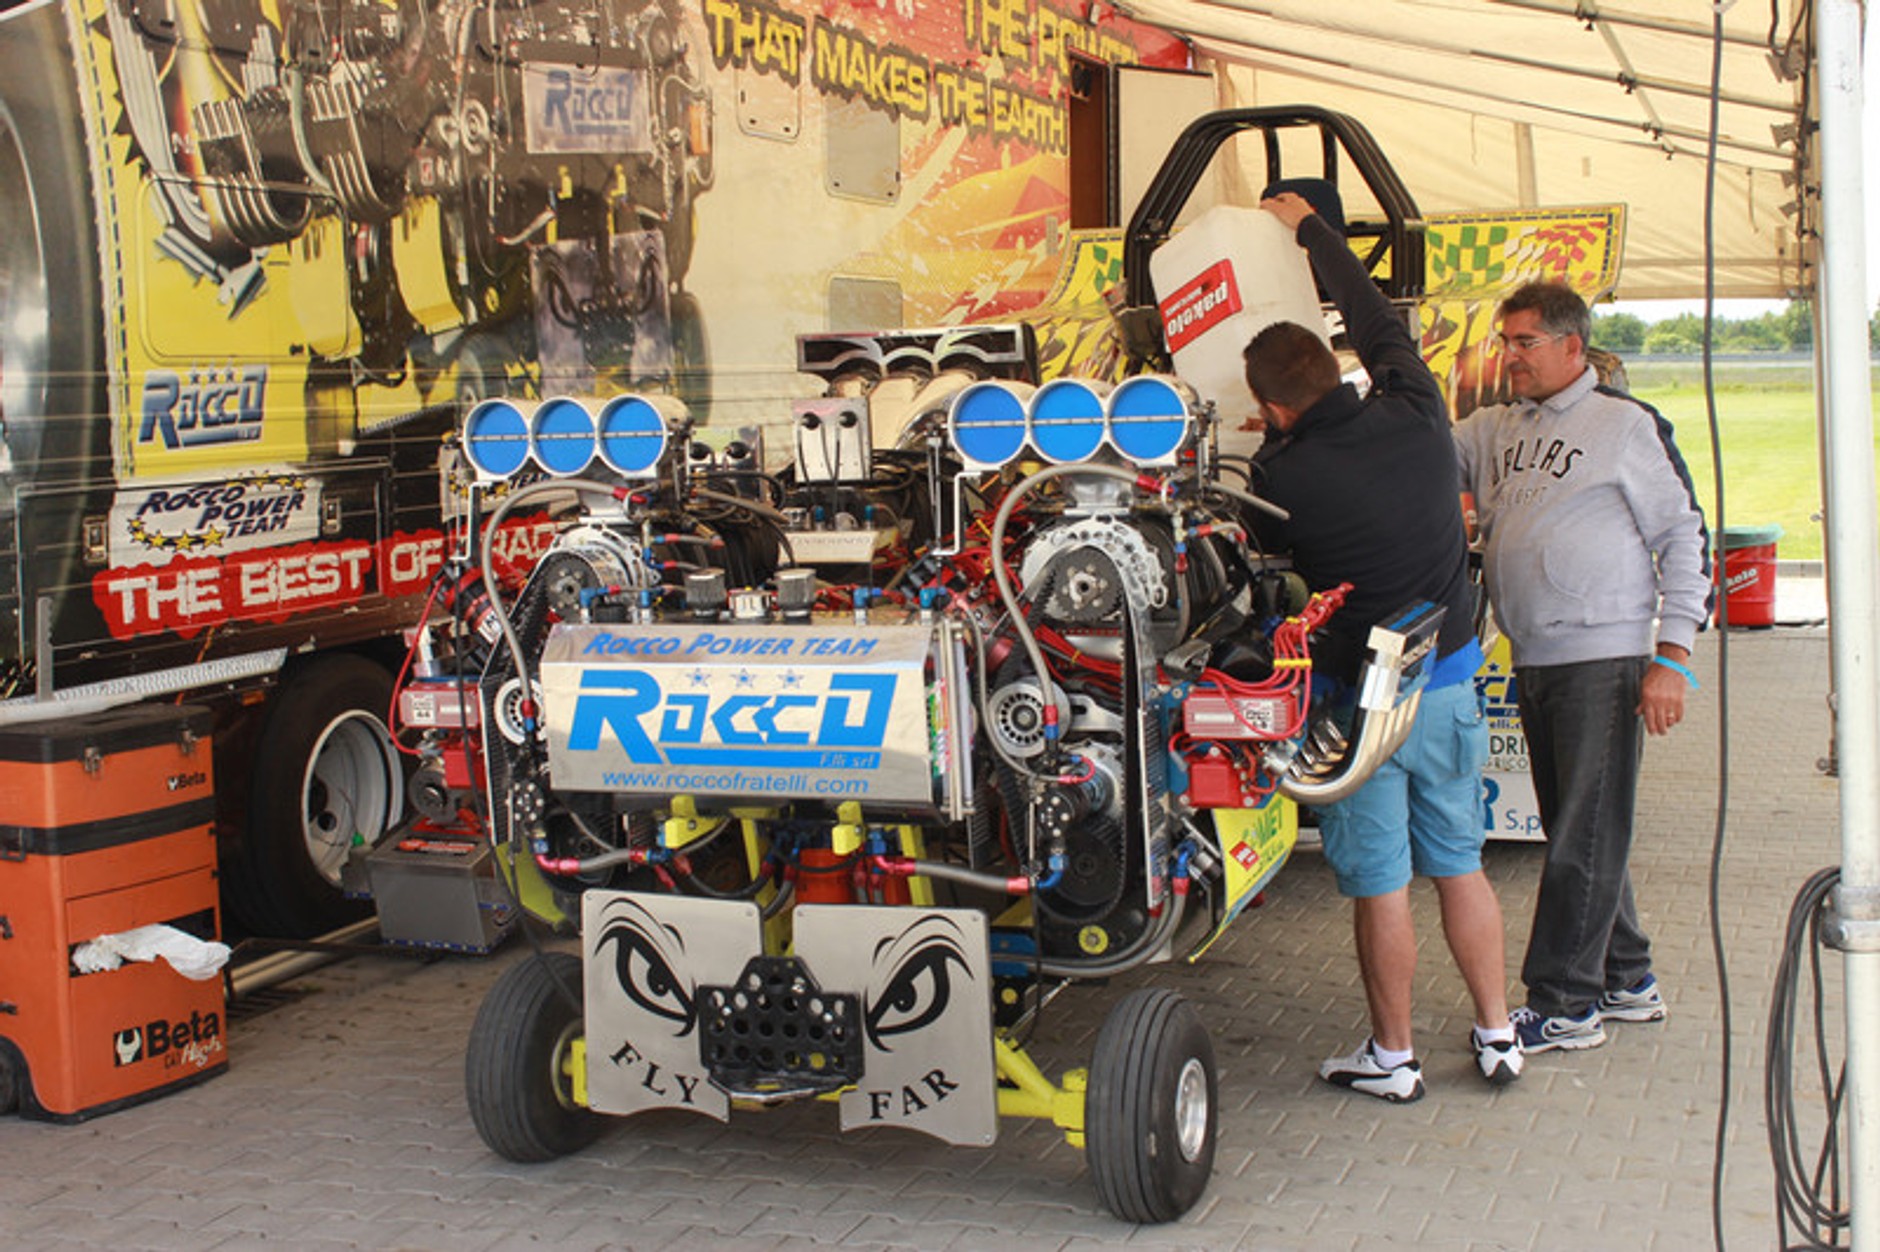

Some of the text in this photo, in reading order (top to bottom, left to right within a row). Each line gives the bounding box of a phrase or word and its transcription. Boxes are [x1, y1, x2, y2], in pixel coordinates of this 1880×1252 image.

[707, 4, 1067, 147] THAT MAKES THE EARTH
[136, 485, 246, 517] ROCCO
[197, 493, 305, 530] POWER
[226, 514, 289, 539] TEAM
[108, 567, 223, 625] THE
[240, 548, 372, 607] BEST
[390, 538, 444, 583] OF
[582, 631, 879, 657] ROCCO POWER TEAM
[567, 669, 899, 765] ROCCO
[601, 770, 869, 795] www.roccofratelli.com
[146, 1010, 220, 1058] Beta
[610, 1041, 700, 1103] FLY
[868, 1068, 960, 1120] FAR
